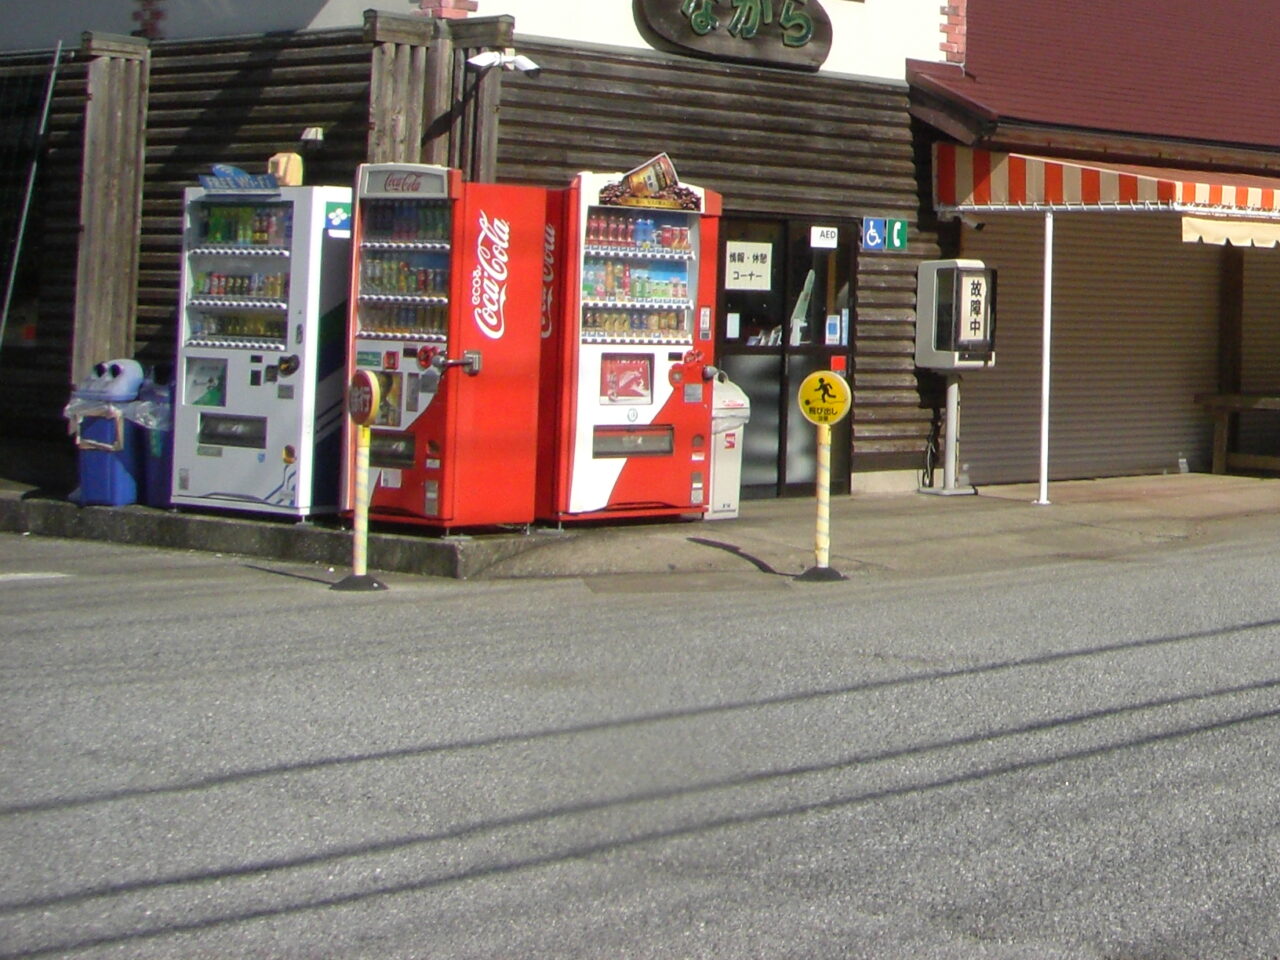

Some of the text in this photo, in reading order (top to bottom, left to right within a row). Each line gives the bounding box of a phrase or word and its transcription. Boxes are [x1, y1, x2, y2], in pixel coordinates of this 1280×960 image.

[820, 230, 836, 239] AED
[729, 252, 768, 264] 情報・休憩
[473, 209, 511, 339] Coca-Cola
[733, 270, 763, 281] コーナー
[970, 280, 982, 336] 故障中
